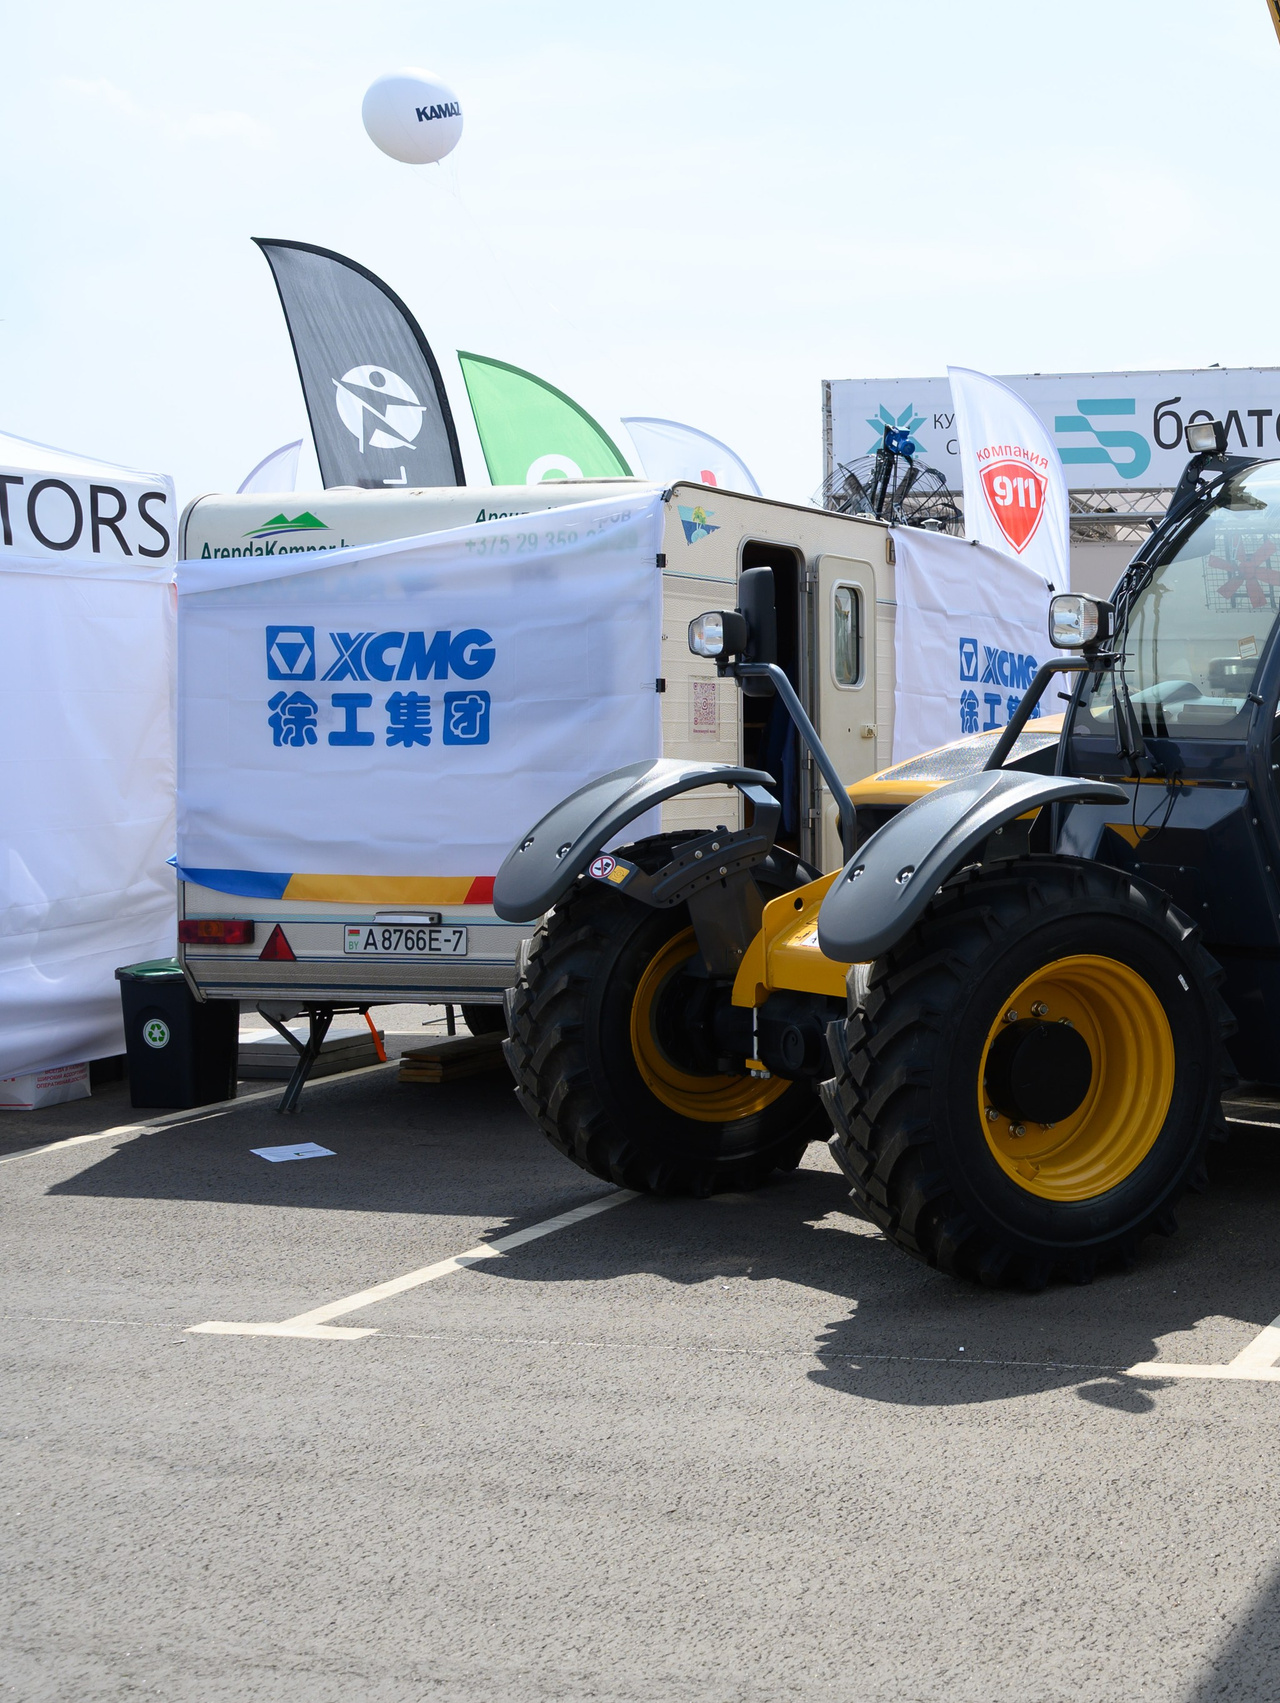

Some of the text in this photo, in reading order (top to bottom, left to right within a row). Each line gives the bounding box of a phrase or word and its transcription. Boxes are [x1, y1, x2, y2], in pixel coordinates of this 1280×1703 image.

[992, 475, 1037, 509] 911
[0, 474, 170, 558] TORS
[320, 628, 496, 682] XCMG
[980, 645, 1038, 690] XCMG
[267, 690, 491, 748] 徐工集团
[960, 689, 1040, 734] 徐工
[348, 941, 359, 950] BY
